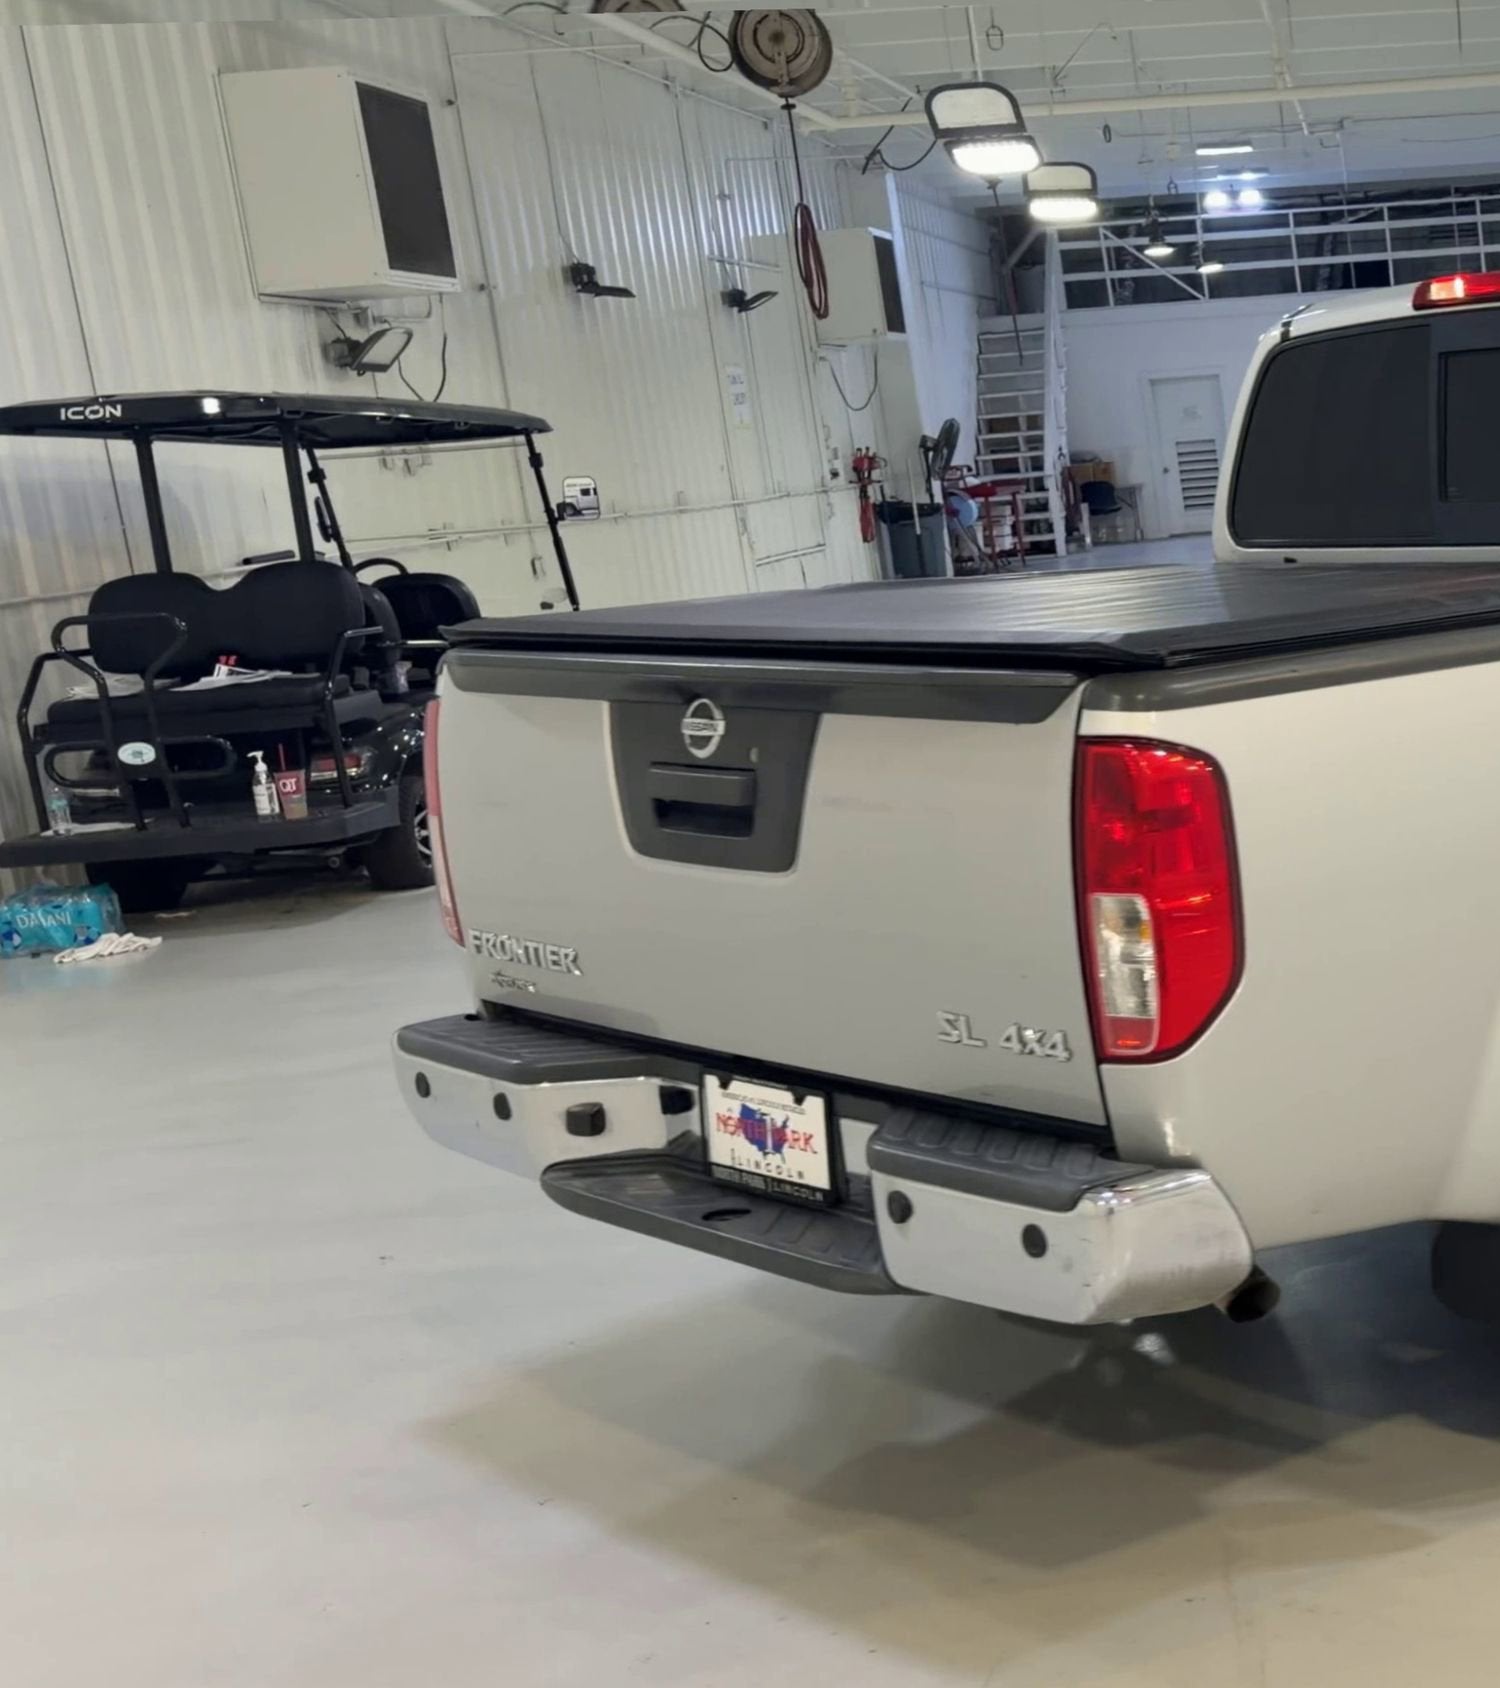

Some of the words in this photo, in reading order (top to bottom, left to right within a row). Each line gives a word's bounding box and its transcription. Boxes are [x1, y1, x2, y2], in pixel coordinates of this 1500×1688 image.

[60, 404, 122, 420] ICON
[280, 778, 297, 793] QT
[469, 929, 583, 975] FRONTIER
[936, 1010, 987, 1048] SL
[737, 1156, 805, 1179] LINCOLN
